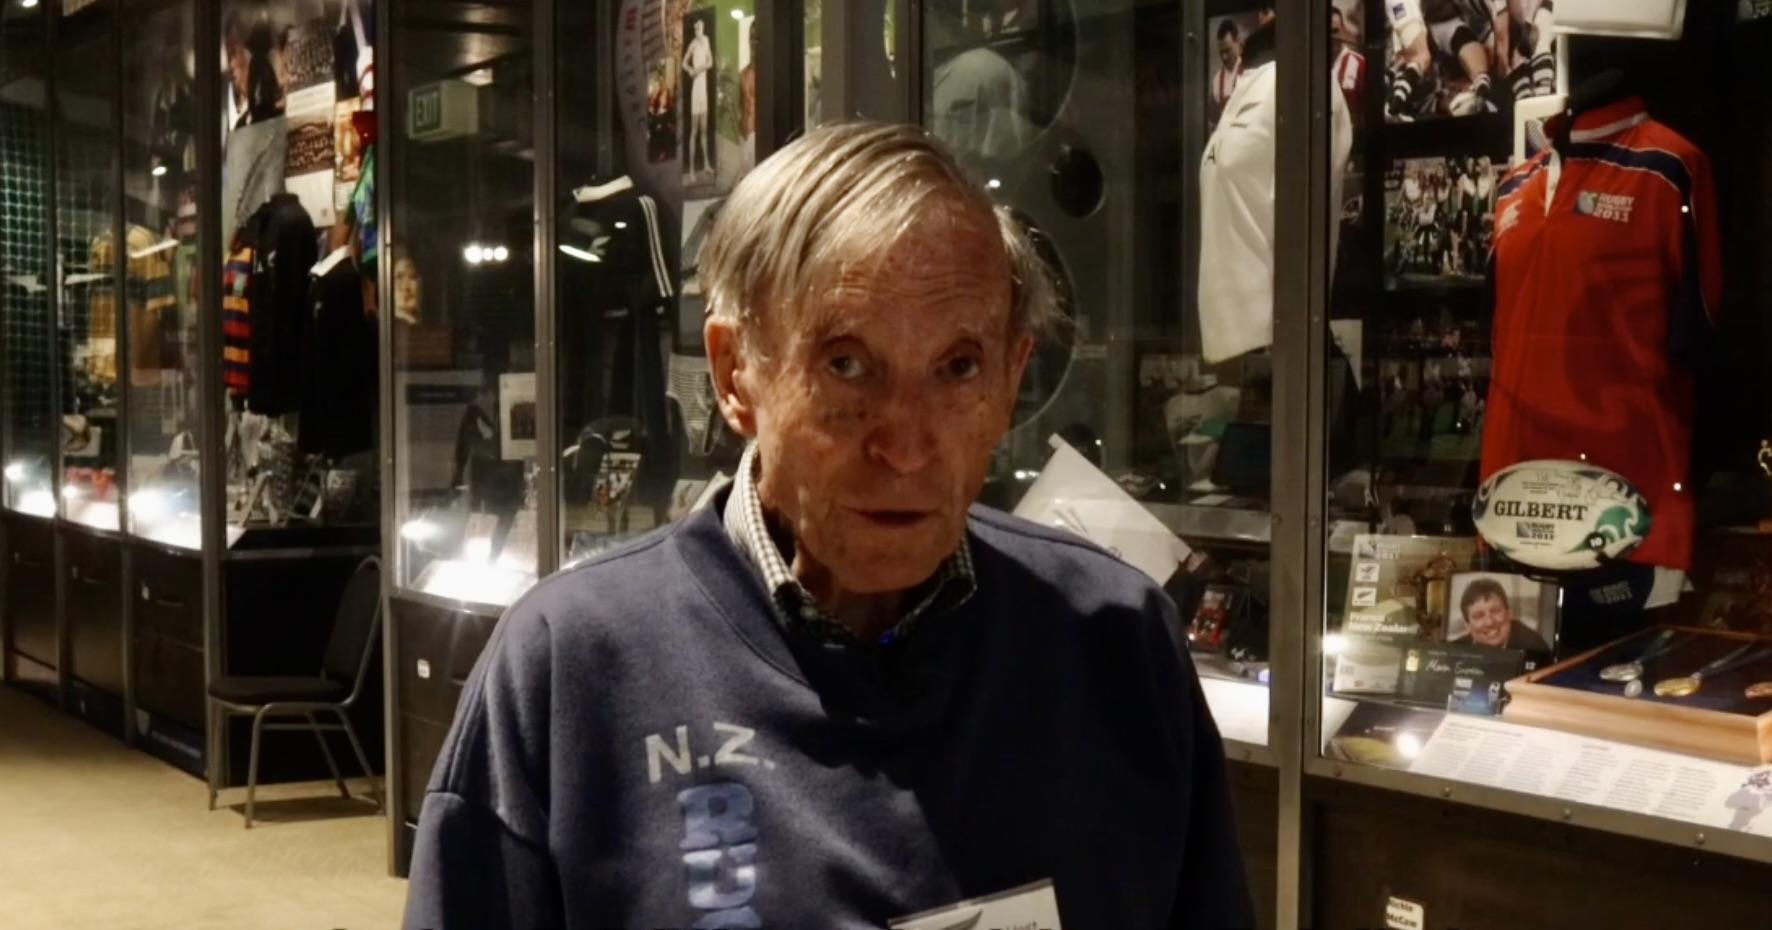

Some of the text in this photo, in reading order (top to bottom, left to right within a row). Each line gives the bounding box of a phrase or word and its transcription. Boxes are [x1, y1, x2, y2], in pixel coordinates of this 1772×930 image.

[415, 93, 438, 127] EXIT
[1599, 192, 1635, 206] RUGBY
[1592, 207, 1629, 223] 2011
[1494, 500, 1588, 521] GILBERT
[1590, 537, 1603, 547] 10
[645, 721, 776, 784] N.Z.
